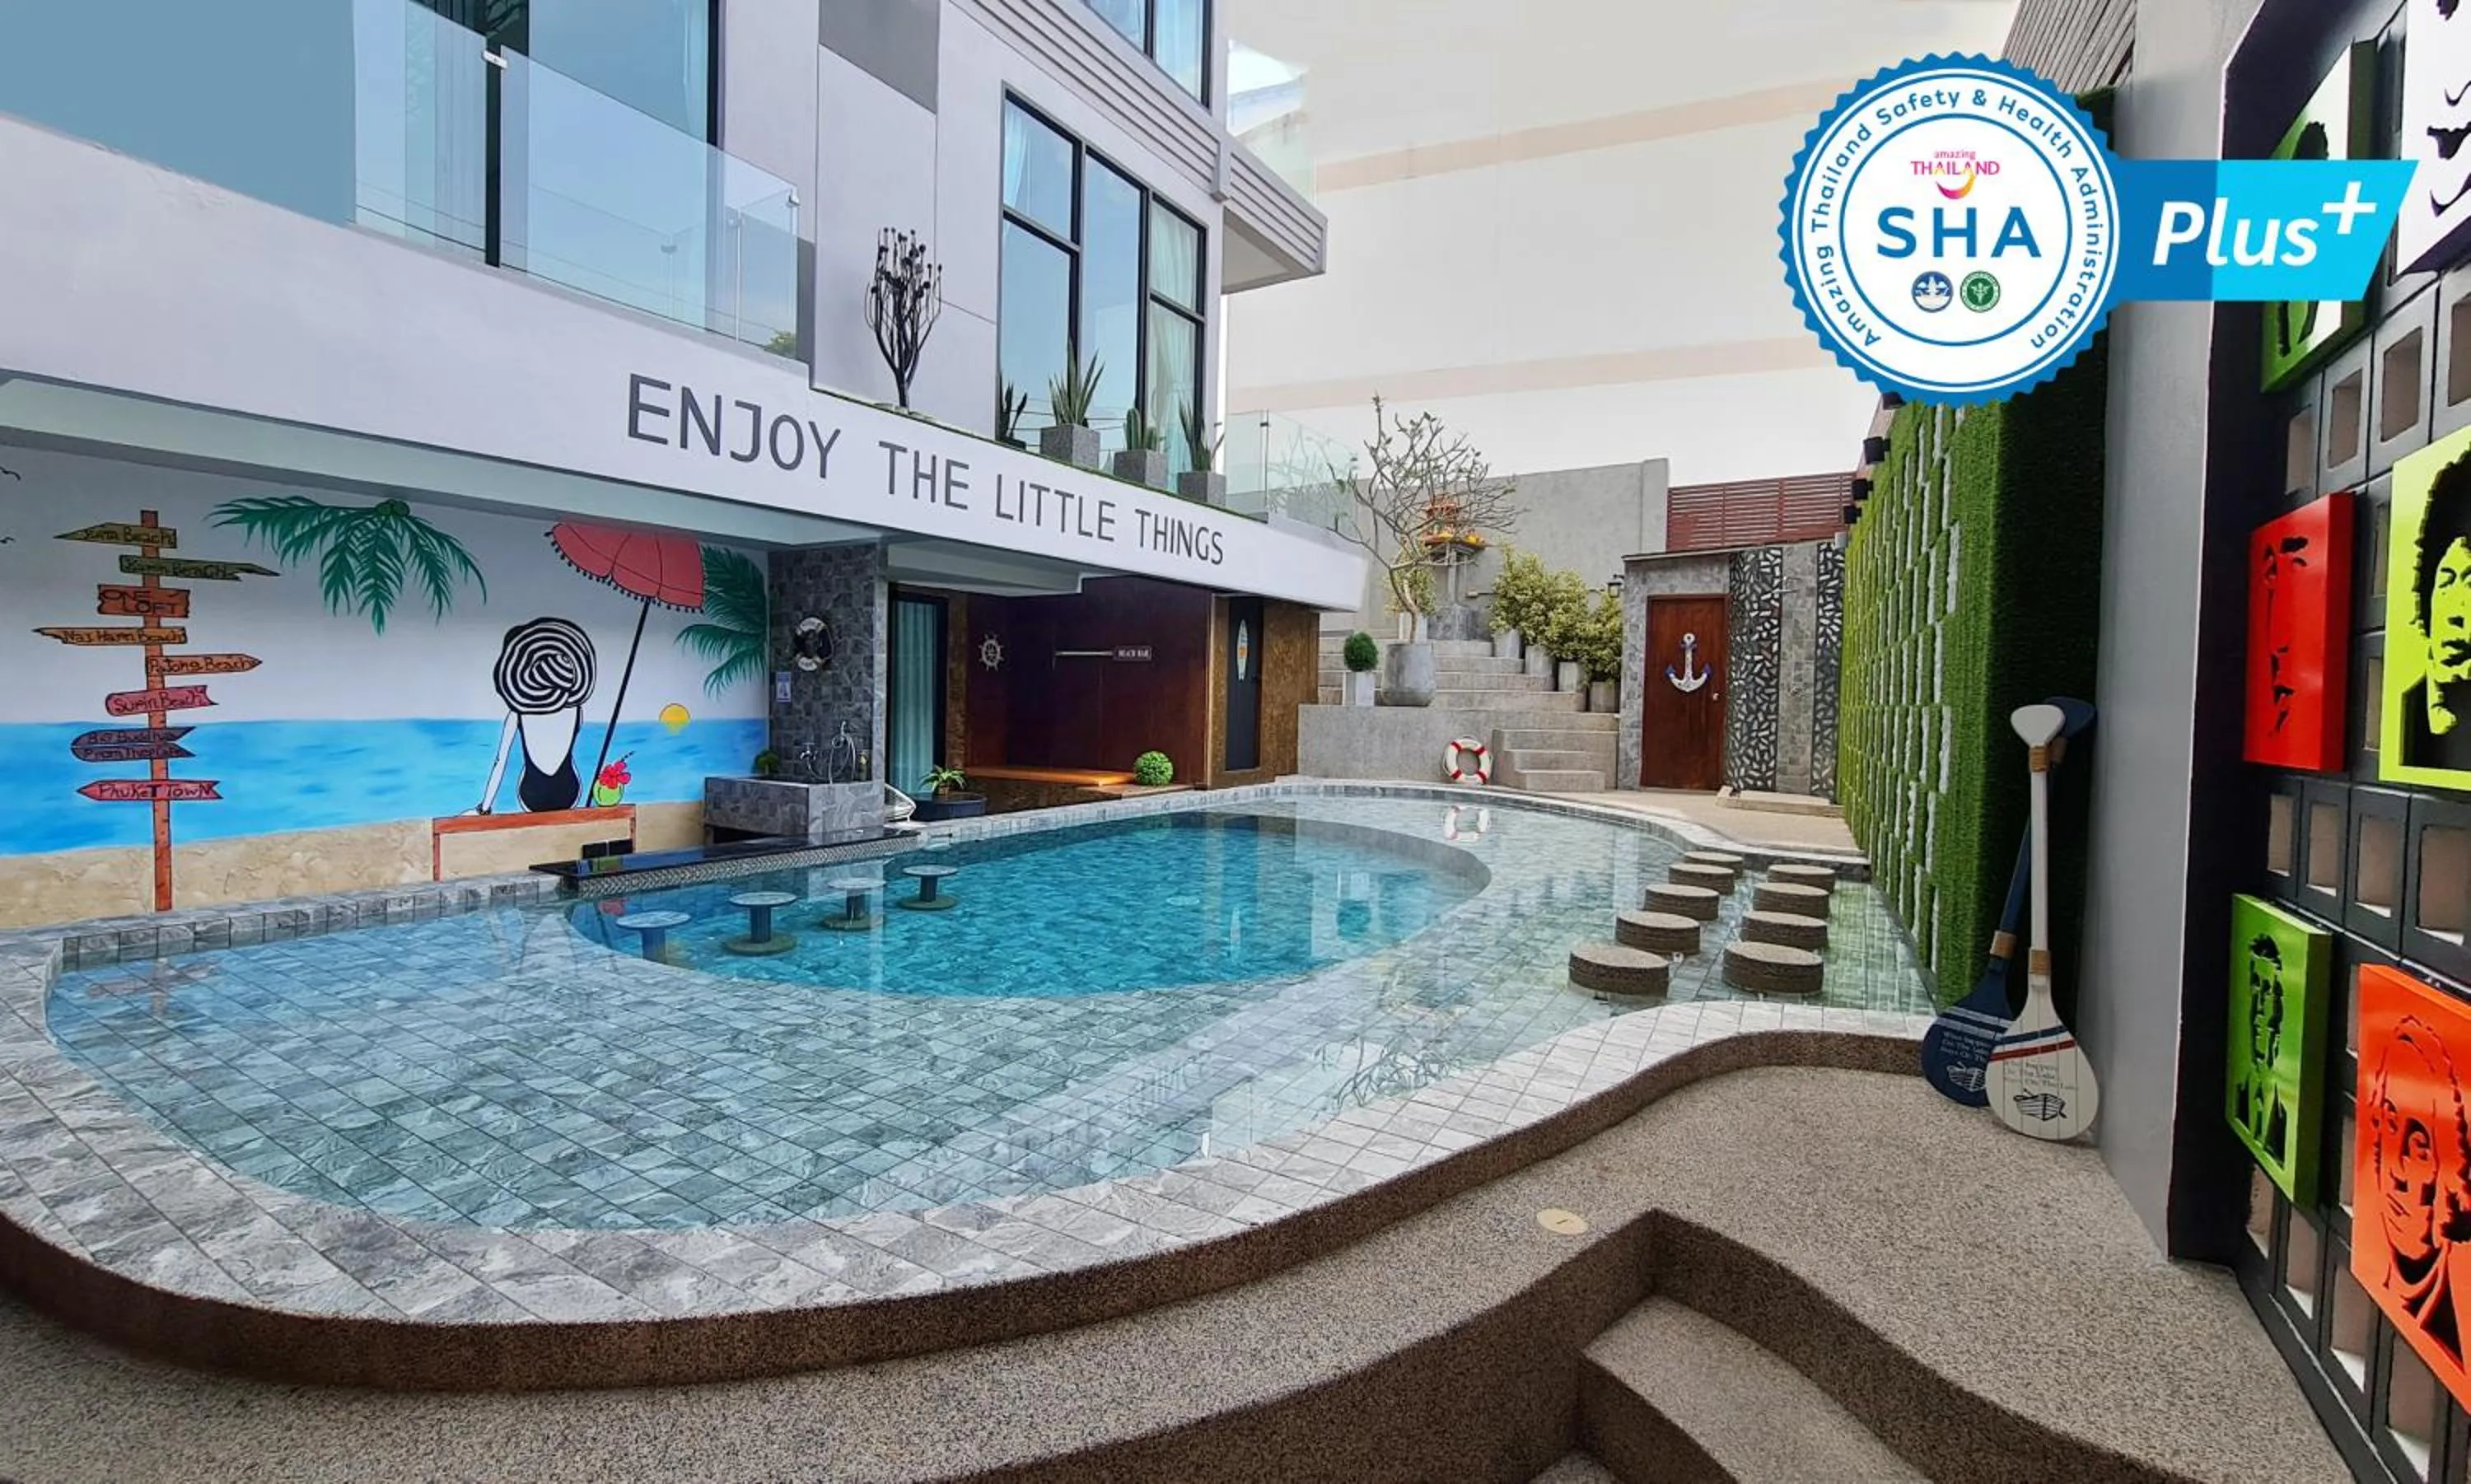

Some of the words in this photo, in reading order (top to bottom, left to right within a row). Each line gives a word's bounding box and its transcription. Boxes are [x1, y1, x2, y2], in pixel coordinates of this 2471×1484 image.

[628, 372, 842, 479] ENJOY
[878, 440, 970, 511] THE
[995, 474, 1116, 542] LITTLE
[1133, 507, 1225, 566] THINGS
[101, 588, 152, 602] ONE
[123, 598, 180, 615] LOFT
[138, 629, 182, 643] Beach
[204, 656, 253, 671] Beach
[114, 697, 157, 714] Surin
[160, 689, 203, 707] Beach
